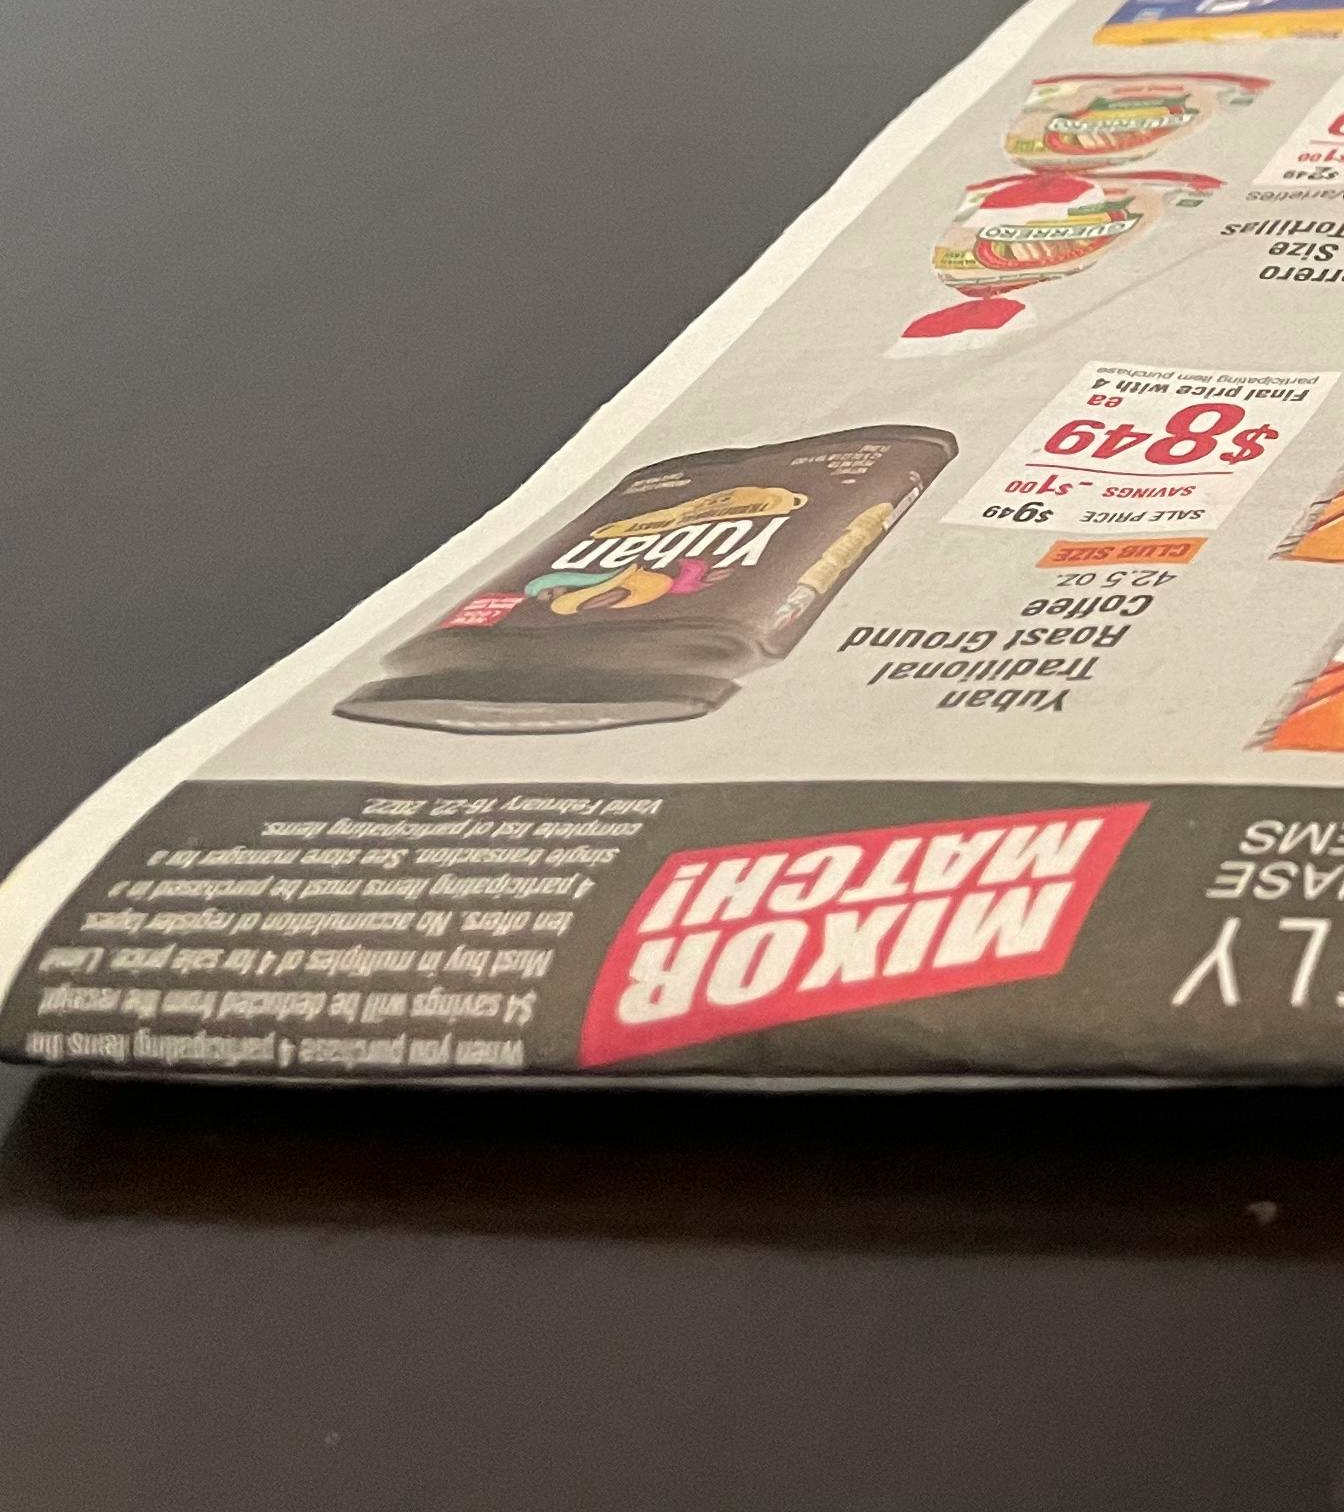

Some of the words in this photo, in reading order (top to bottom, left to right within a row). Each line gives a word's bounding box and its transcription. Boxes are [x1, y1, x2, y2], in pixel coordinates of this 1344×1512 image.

[986, 223, 1125, 240] GUERRERO
[1268, 242, 1339, 261] Size
[1091, 378, 1110, 389] 4
[1115, 381, 1170, 394] with
[1174, 384, 1240, 400] price
[1087, 395, 1123, 407] ea
[1248, 389, 1309, 402] Final
[551, 517, 789, 569] Yuban
[1115, 543, 1191, 559] CLUB
[1052, 546, 1115, 561] SIZE
[1055, 572, 1095, 588] oz.
[1106, 570, 1177, 587] 42.5
[1020, 594, 1154, 618] Coffee
[837, 626, 998, 652] Ground
[1003, 625, 1131, 649] Roast
[866, 657, 1099, 684] Traditional
[935, 689, 1071, 712] Yuban
[500, 795, 603, 815] February
[601, 798, 663, 814] Valid
[146, 850, 169, 865] a
[165, 850, 202, 867] for
[197, 846, 301, 864] manager
[300, 849, 361, 866] store
[359, 849, 409, 868] See
[415, 848, 545, 865] transaction.
[544, 845, 620, 867] single
[638, 818, 1104, 933] MATCH!
[795, 881, 1075, 991] MIX
[617, 919, 807, 1024] OR
